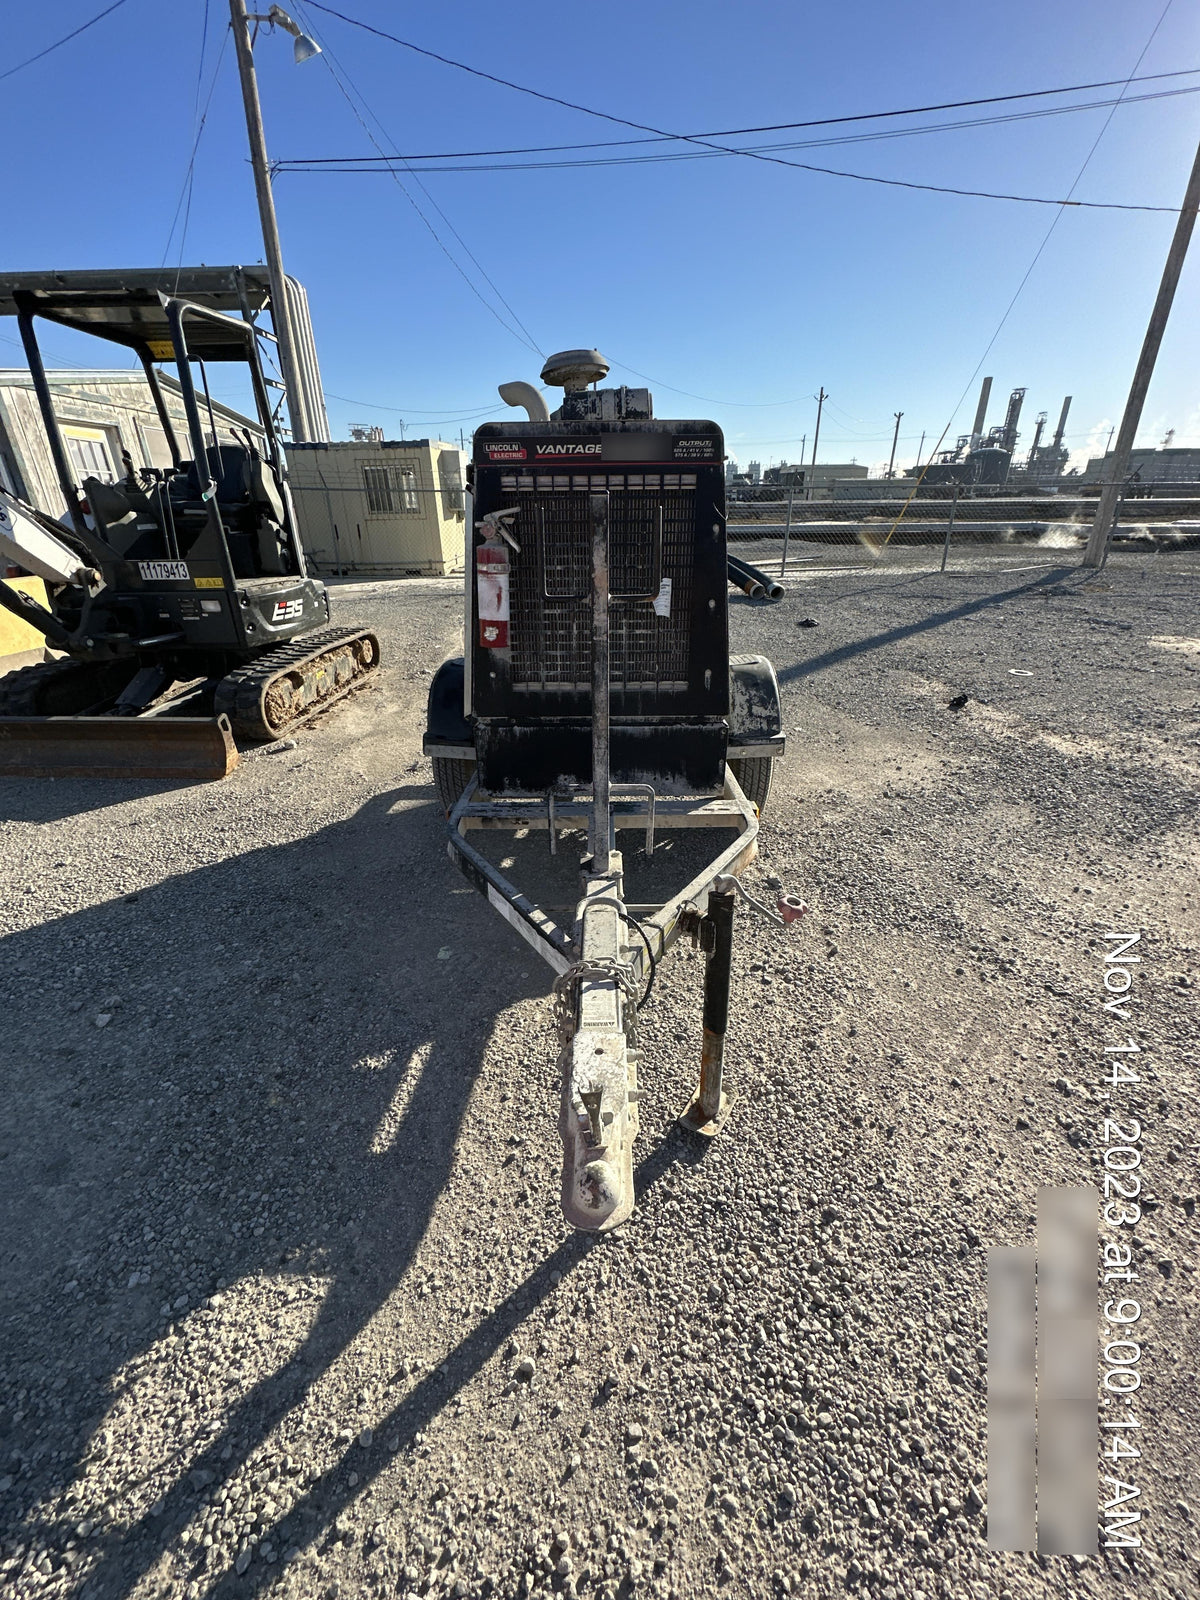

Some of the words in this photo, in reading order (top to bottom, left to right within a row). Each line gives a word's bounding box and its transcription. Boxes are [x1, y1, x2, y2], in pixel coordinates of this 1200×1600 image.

[485, 444, 519, 452] LINCOLN
[536, 444, 602, 454] VANTAGE
[141, 563, 188, 579] 11179413
[272, 599, 304, 622] E35
